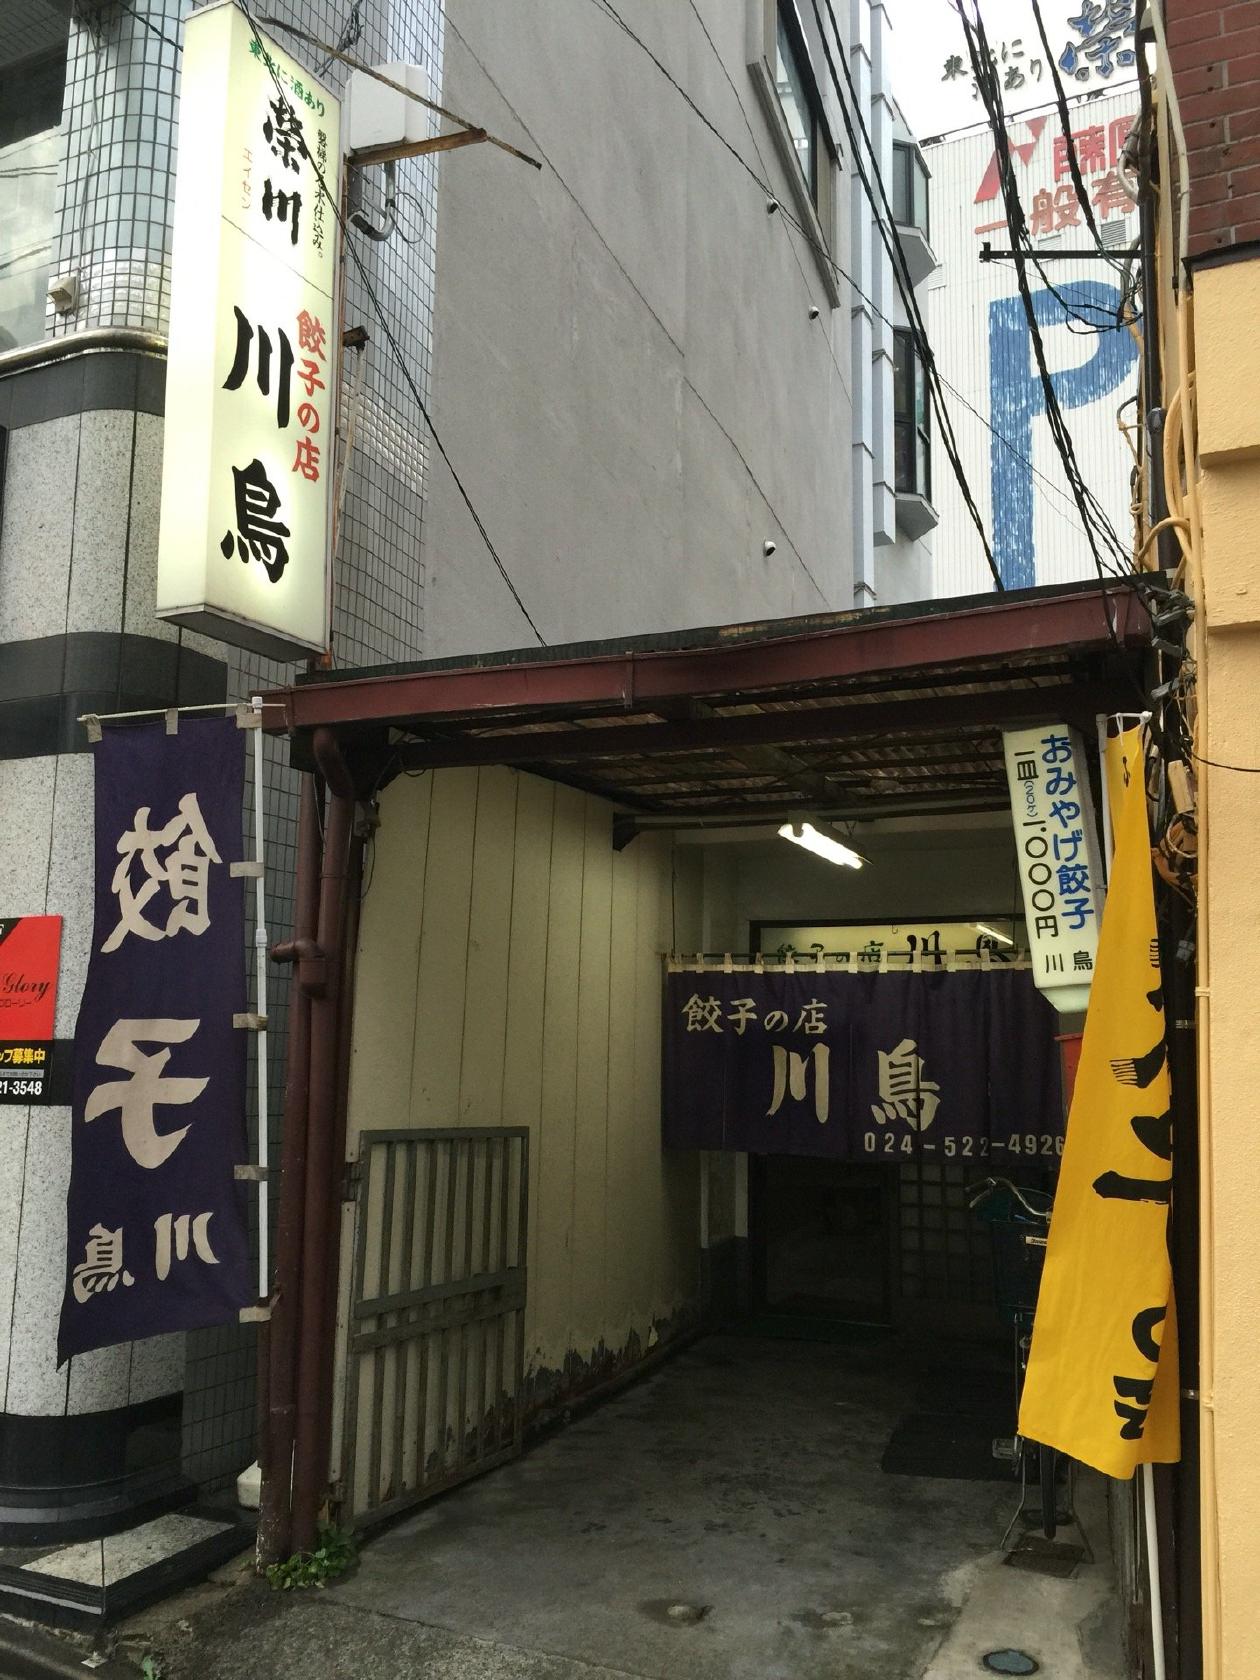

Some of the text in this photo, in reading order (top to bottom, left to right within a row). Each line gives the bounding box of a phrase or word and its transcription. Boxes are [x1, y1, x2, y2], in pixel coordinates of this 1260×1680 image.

[292, 309, 327, 482] 餃子の店
[220, 305, 292, 584] 川鳥
[1040, 734, 1095, 930] おみやげ餃子
[3, 971, 51, 1001] Glory
[1046, 951, 1094, 973] 川鳥
[681, 993, 828, 1036] 餃子の店
[765, 1038, 941, 1132] 川鳥
